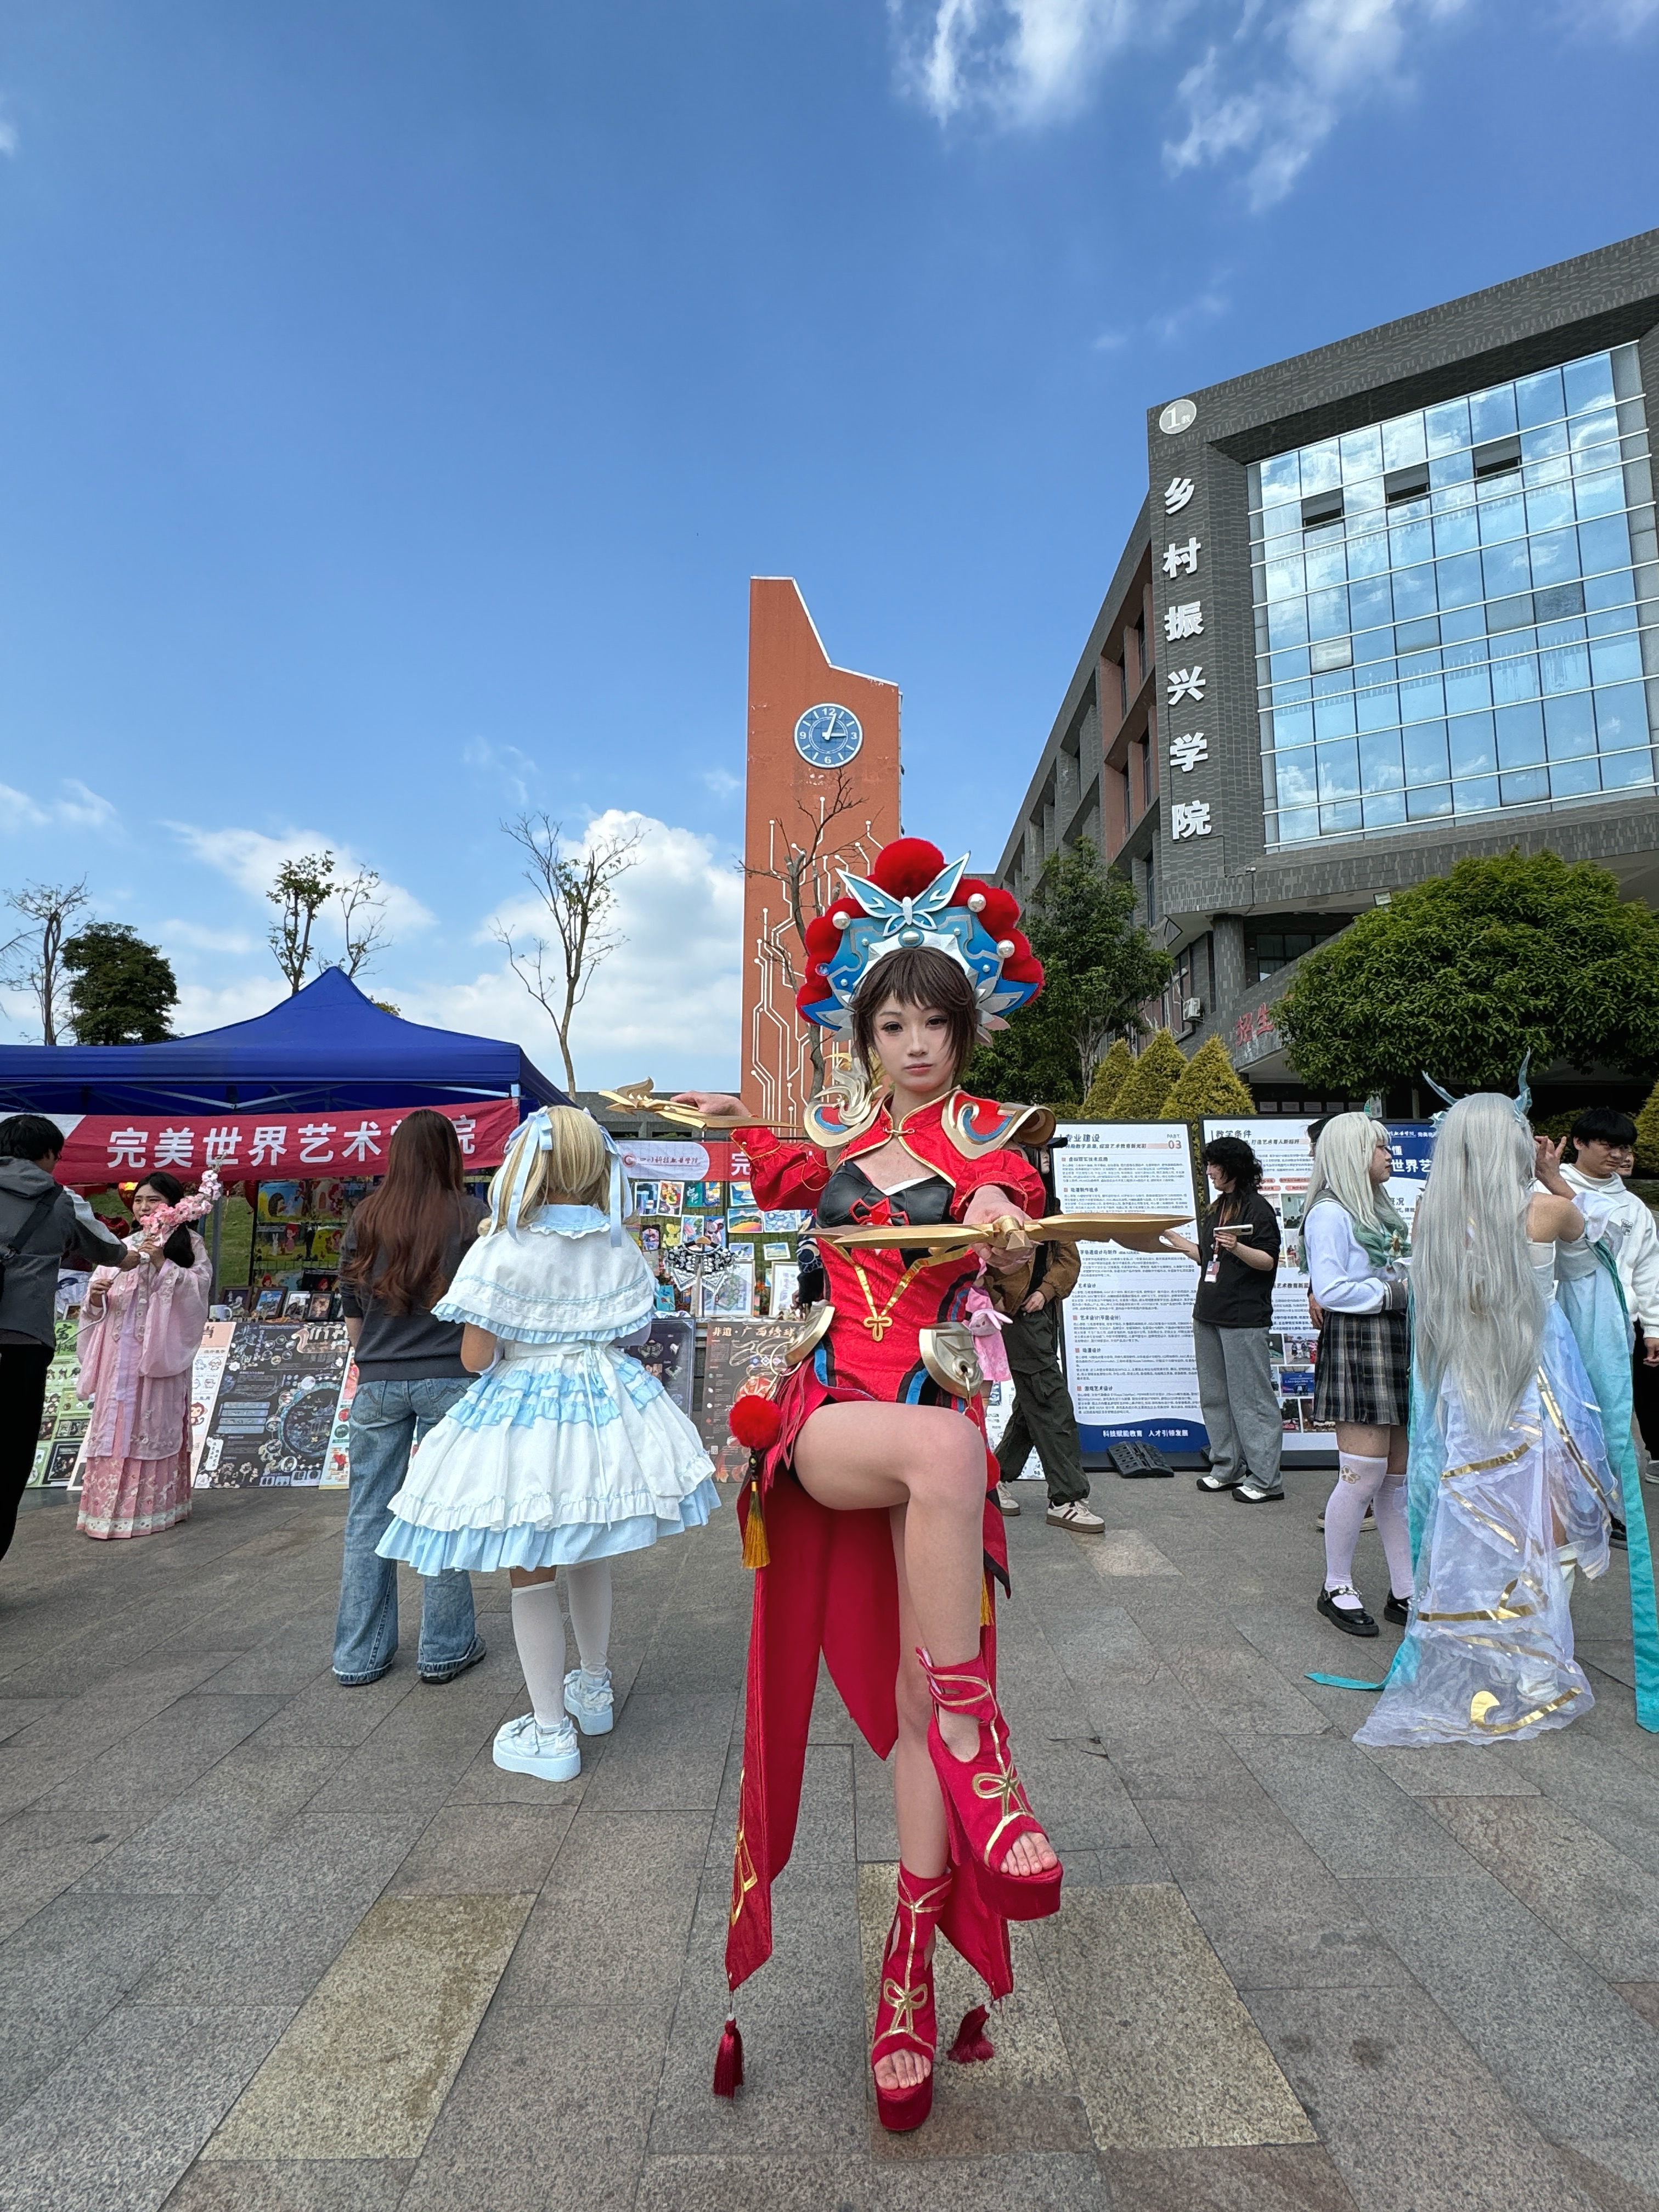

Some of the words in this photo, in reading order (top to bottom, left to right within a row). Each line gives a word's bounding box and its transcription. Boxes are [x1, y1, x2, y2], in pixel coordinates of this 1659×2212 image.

[1163, 476, 1211, 841] 乡村振兴学院
[822, 708, 836, 716] 12
[850, 731, 858, 740] 3
[1216, 1129, 1252, 1139] 教学条件
[106, 1115, 477, 1168] 完美世界艺术院
[1168, 1140, 1182, 1149] 03
[1103, 1430, 1143, 1438] 科技赋能教育
[1148, 1430, 1189, 1438] 人才引领发展
